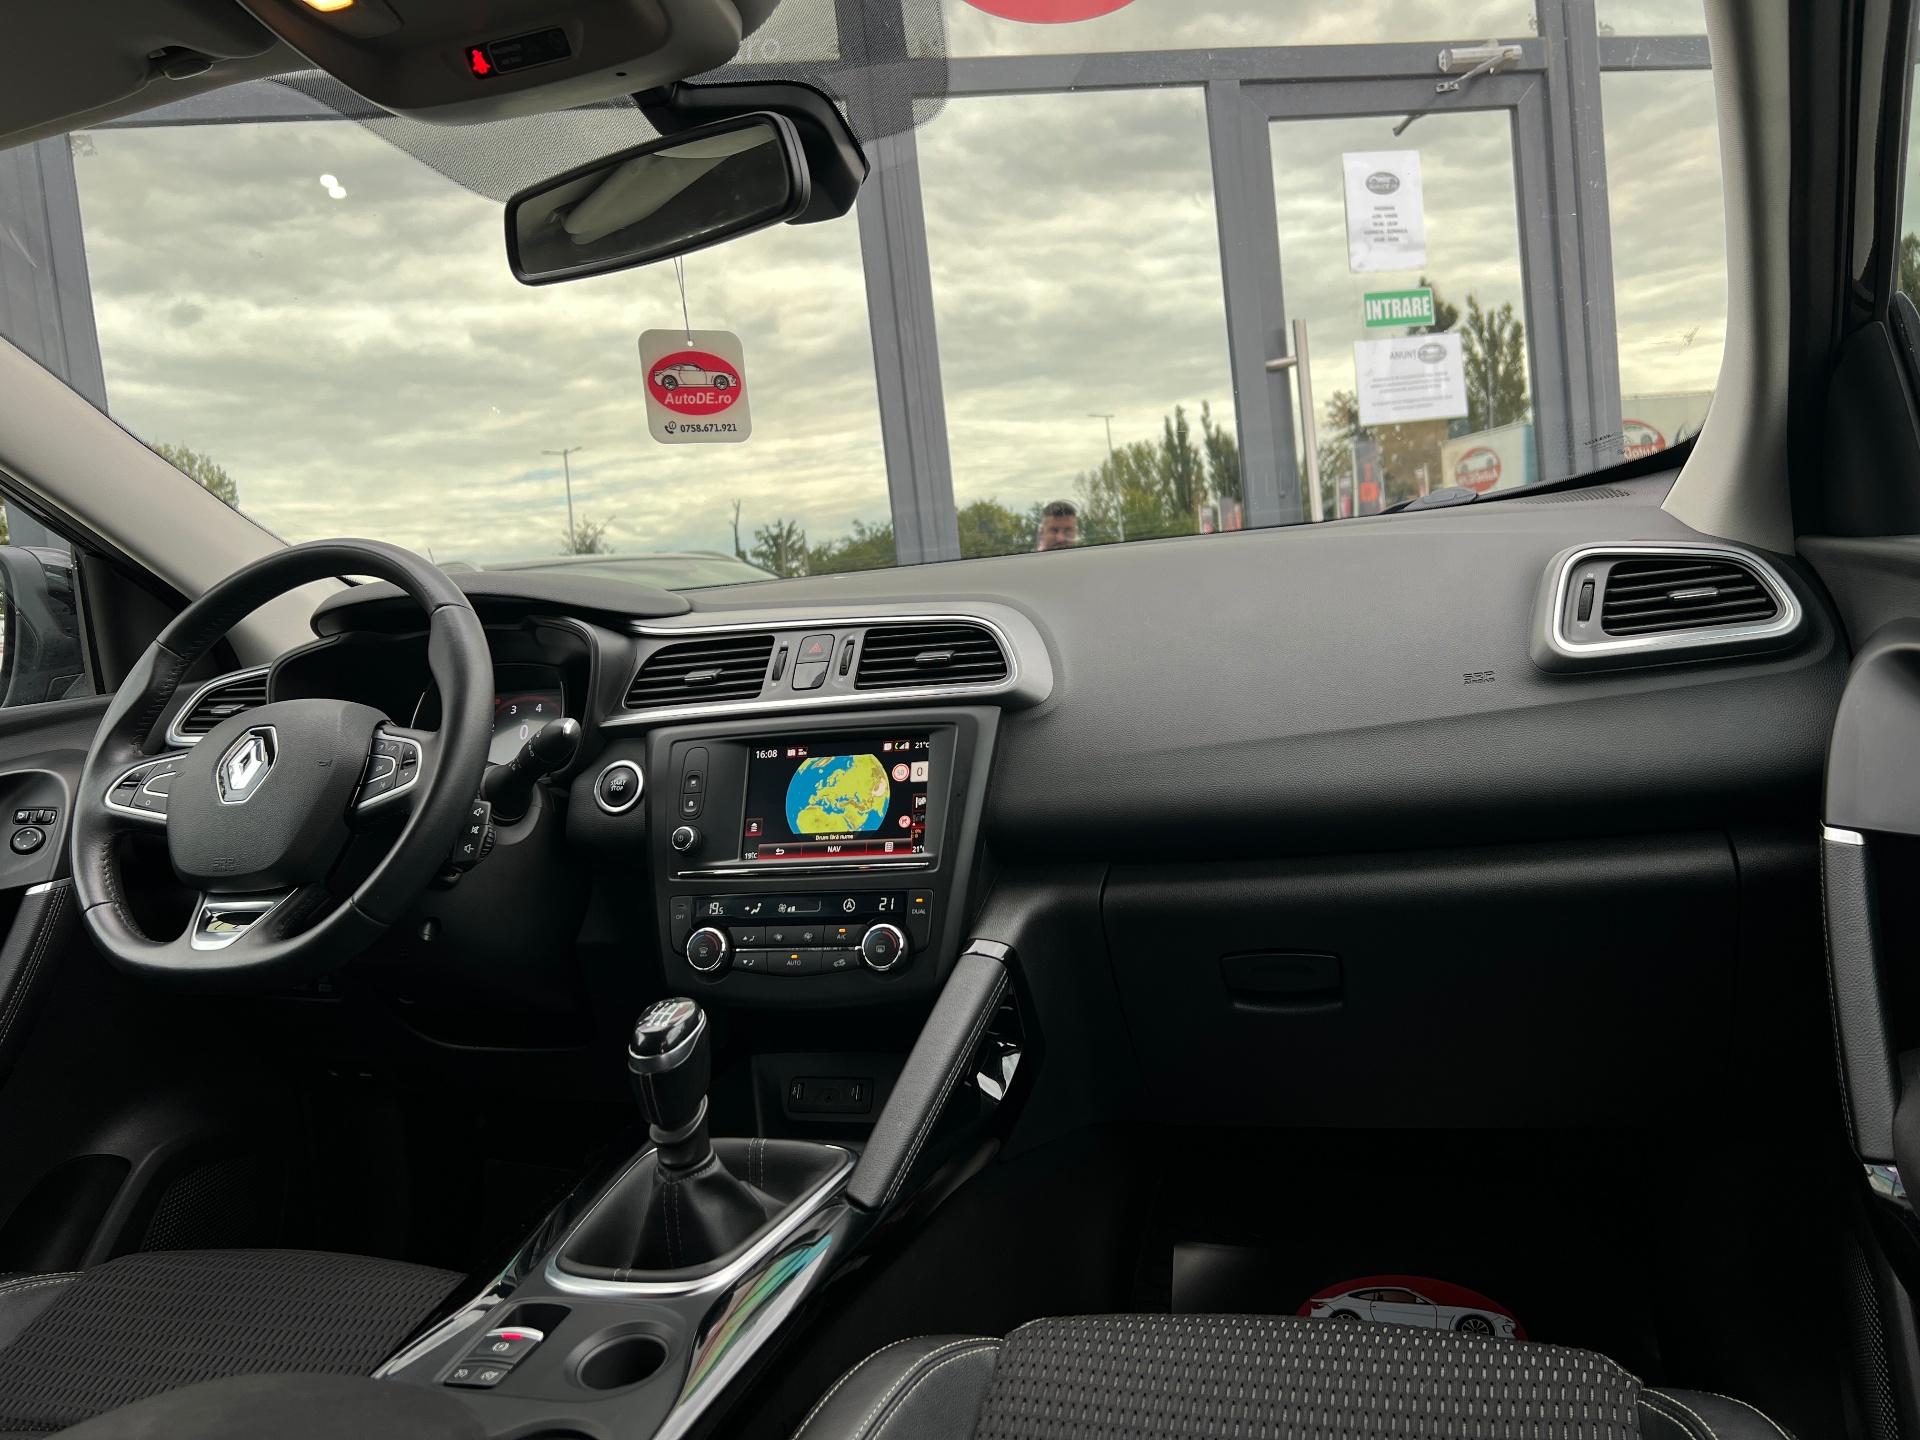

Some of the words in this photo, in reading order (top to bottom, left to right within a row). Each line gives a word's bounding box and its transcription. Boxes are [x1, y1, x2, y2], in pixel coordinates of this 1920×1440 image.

[1366, 297, 1431, 320] INTRARE
[664, 392, 732, 405] AutoDE.ro
[680, 423, 737, 433] 0758.671.921
[510, 705, 517, 715] 3
[535, 703, 542, 713] 4
[520, 724, 529, 740] 0
[755, 749, 778, 759] 16:08
[827, 845, 842, 853] NAV
[878, 897, 895, 911] 21
